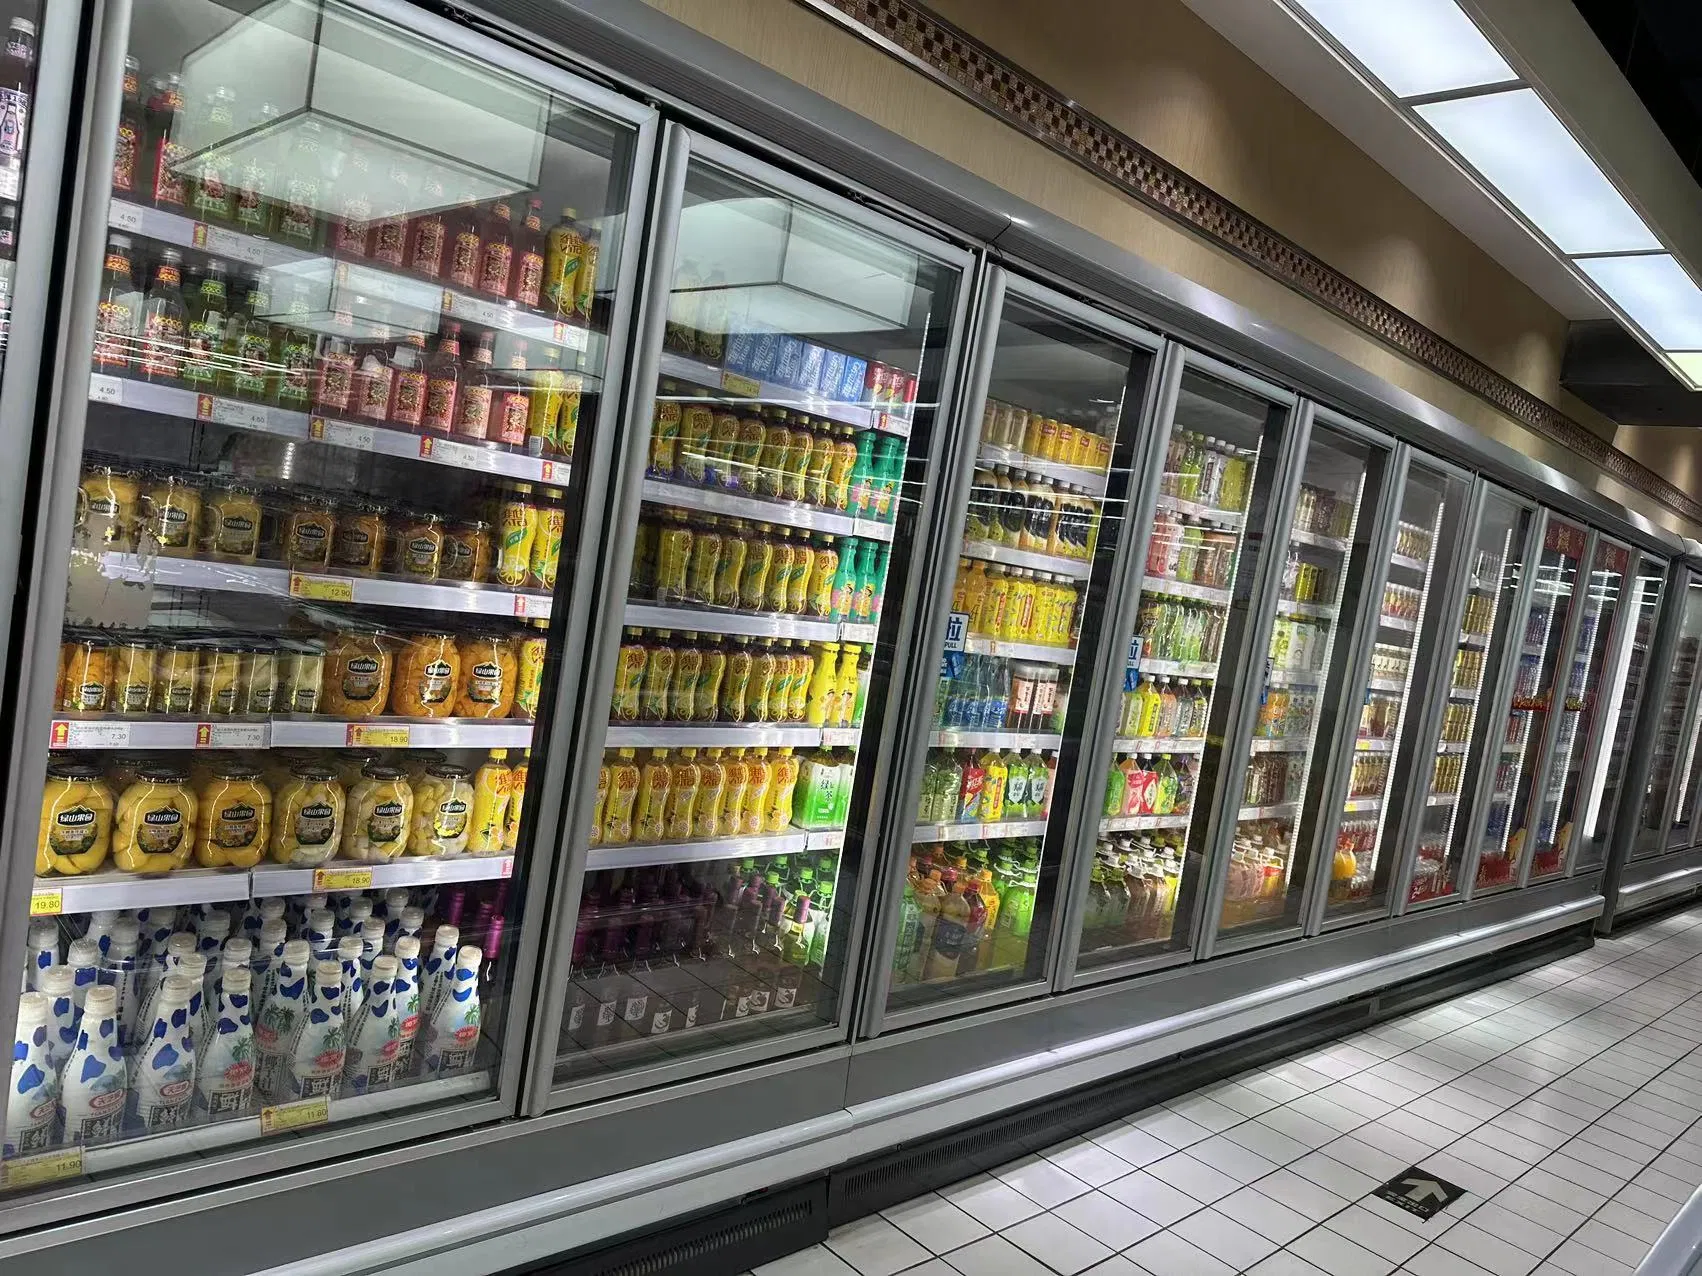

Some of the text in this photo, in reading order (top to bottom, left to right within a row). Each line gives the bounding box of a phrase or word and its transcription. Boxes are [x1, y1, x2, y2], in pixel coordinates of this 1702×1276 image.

[331, 588, 350, 597] 12.90
[944, 641, 957, 649] PULL
[35, 900, 60, 910] 19.80
[57, 1159, 82, 1172] 11.90
